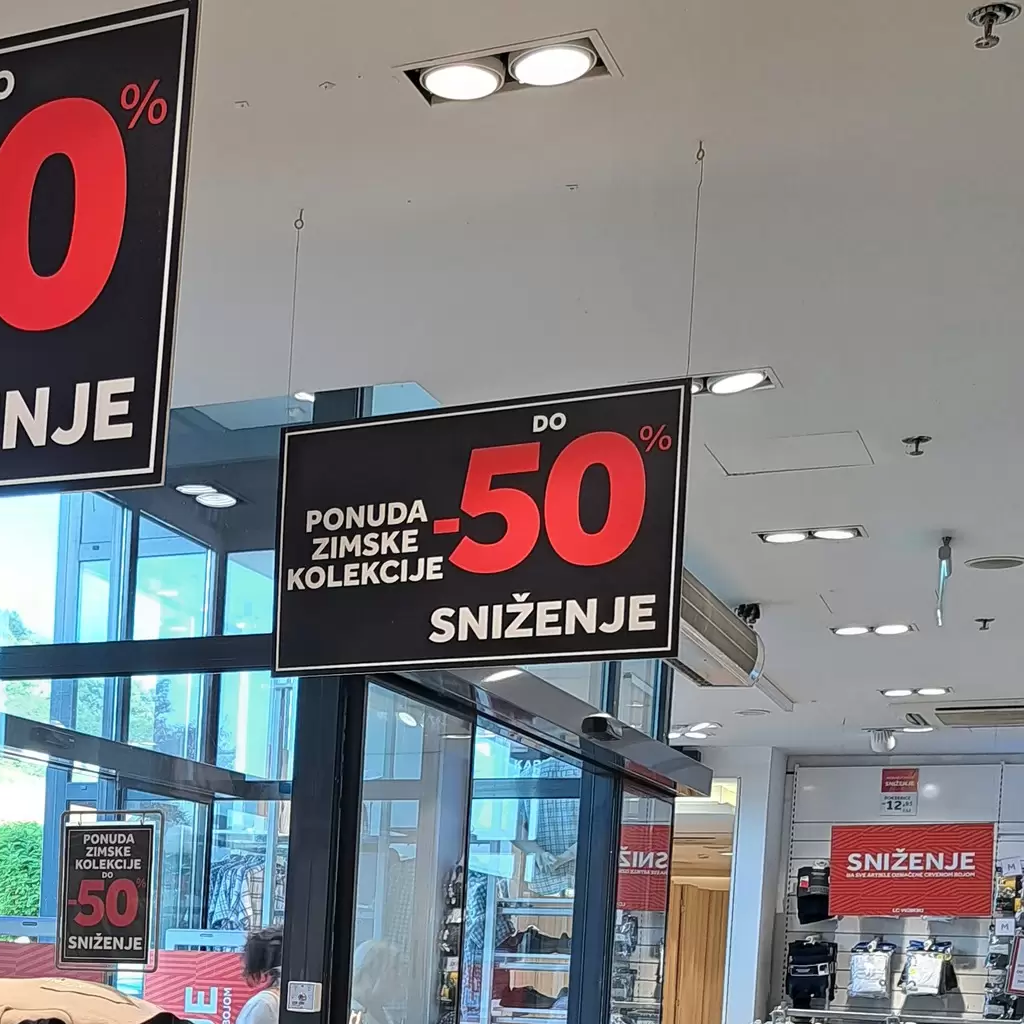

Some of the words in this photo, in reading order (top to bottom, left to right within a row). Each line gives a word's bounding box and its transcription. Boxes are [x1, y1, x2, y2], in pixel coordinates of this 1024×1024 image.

[532, 412, 567, 433] DO
[306, 499, 428, 533] PONUDA
[311, 529, 419, 561] ZIMSKE
[287, 556, 444, 590] KOLEKCIJE
[428, 592, 656, 644] SNIŽENJE
[83, 833, 135, 845] PONUDA
[85, 846, 131, 857] ZIMSKE
[847, 848, 975, 871] SNIŽENJE
[75, 858, 141, 870] KOLEKCIJE
[101, 871, 114, 879] DO
[68, 932, 143, 950] SNIŽENJE
